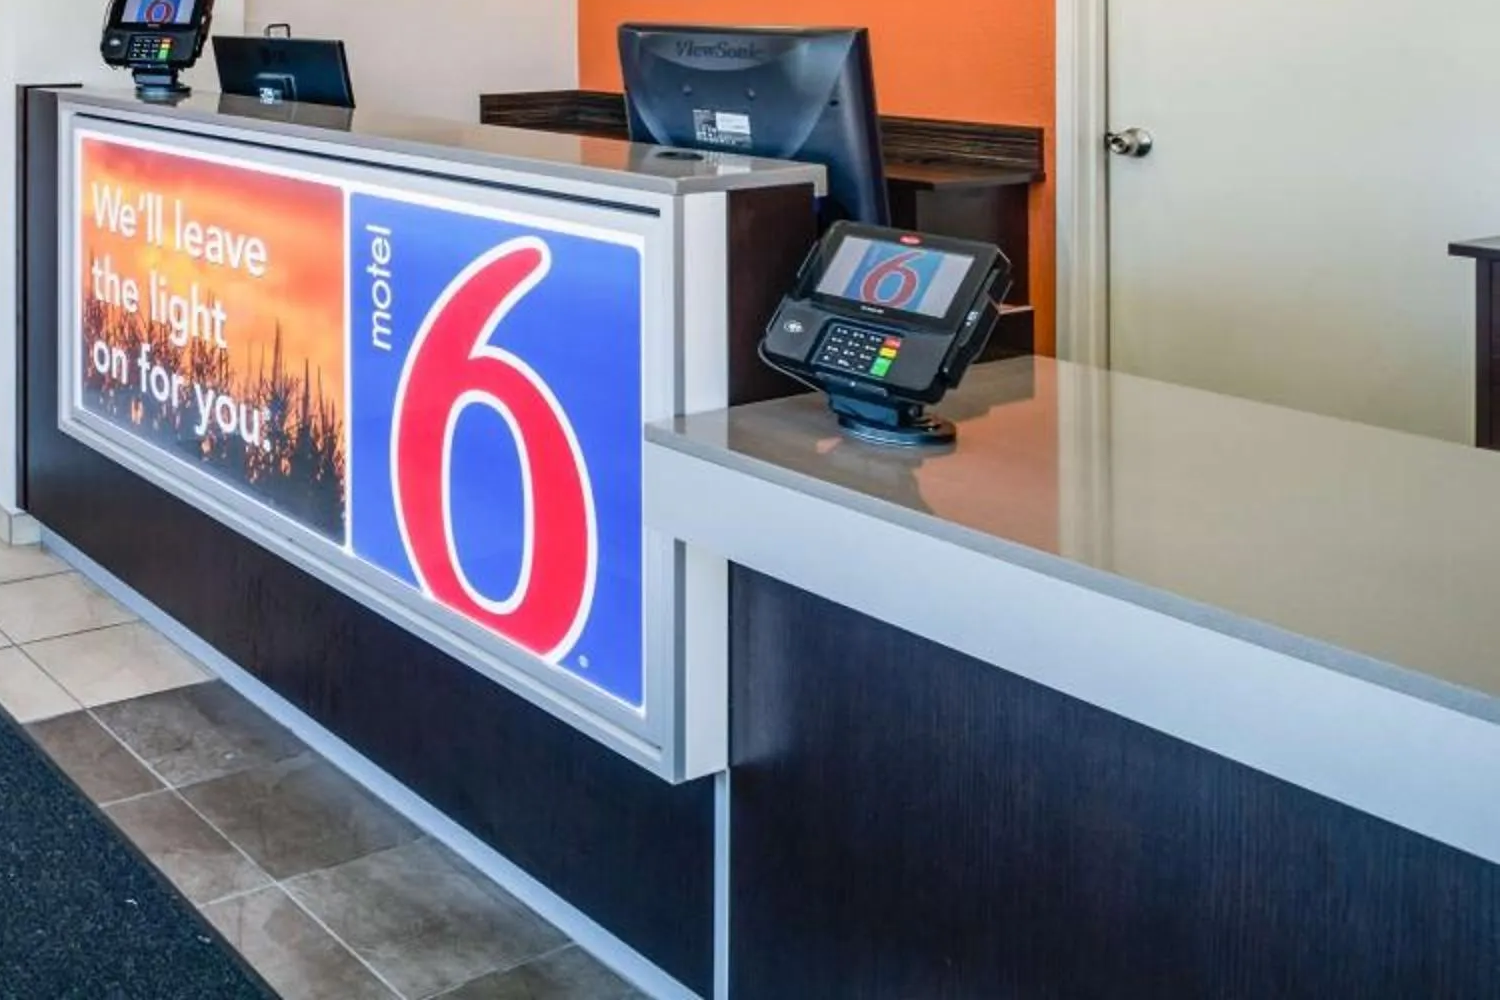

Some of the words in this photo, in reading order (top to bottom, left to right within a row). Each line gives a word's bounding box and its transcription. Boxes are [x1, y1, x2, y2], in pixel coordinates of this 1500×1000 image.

[91, 181, 164, 247] We'll
[174, 199, 268, 277] leave
[92, 255, 140, 313] the
[151, 270, 228, 349] light
[366, 224, 392, 351] motel
[860, 249, 924, 309] 6
[93, 341, 128, 385] on
[138, 343, 185, 408] for
[389, 235, 599, 666] 6
